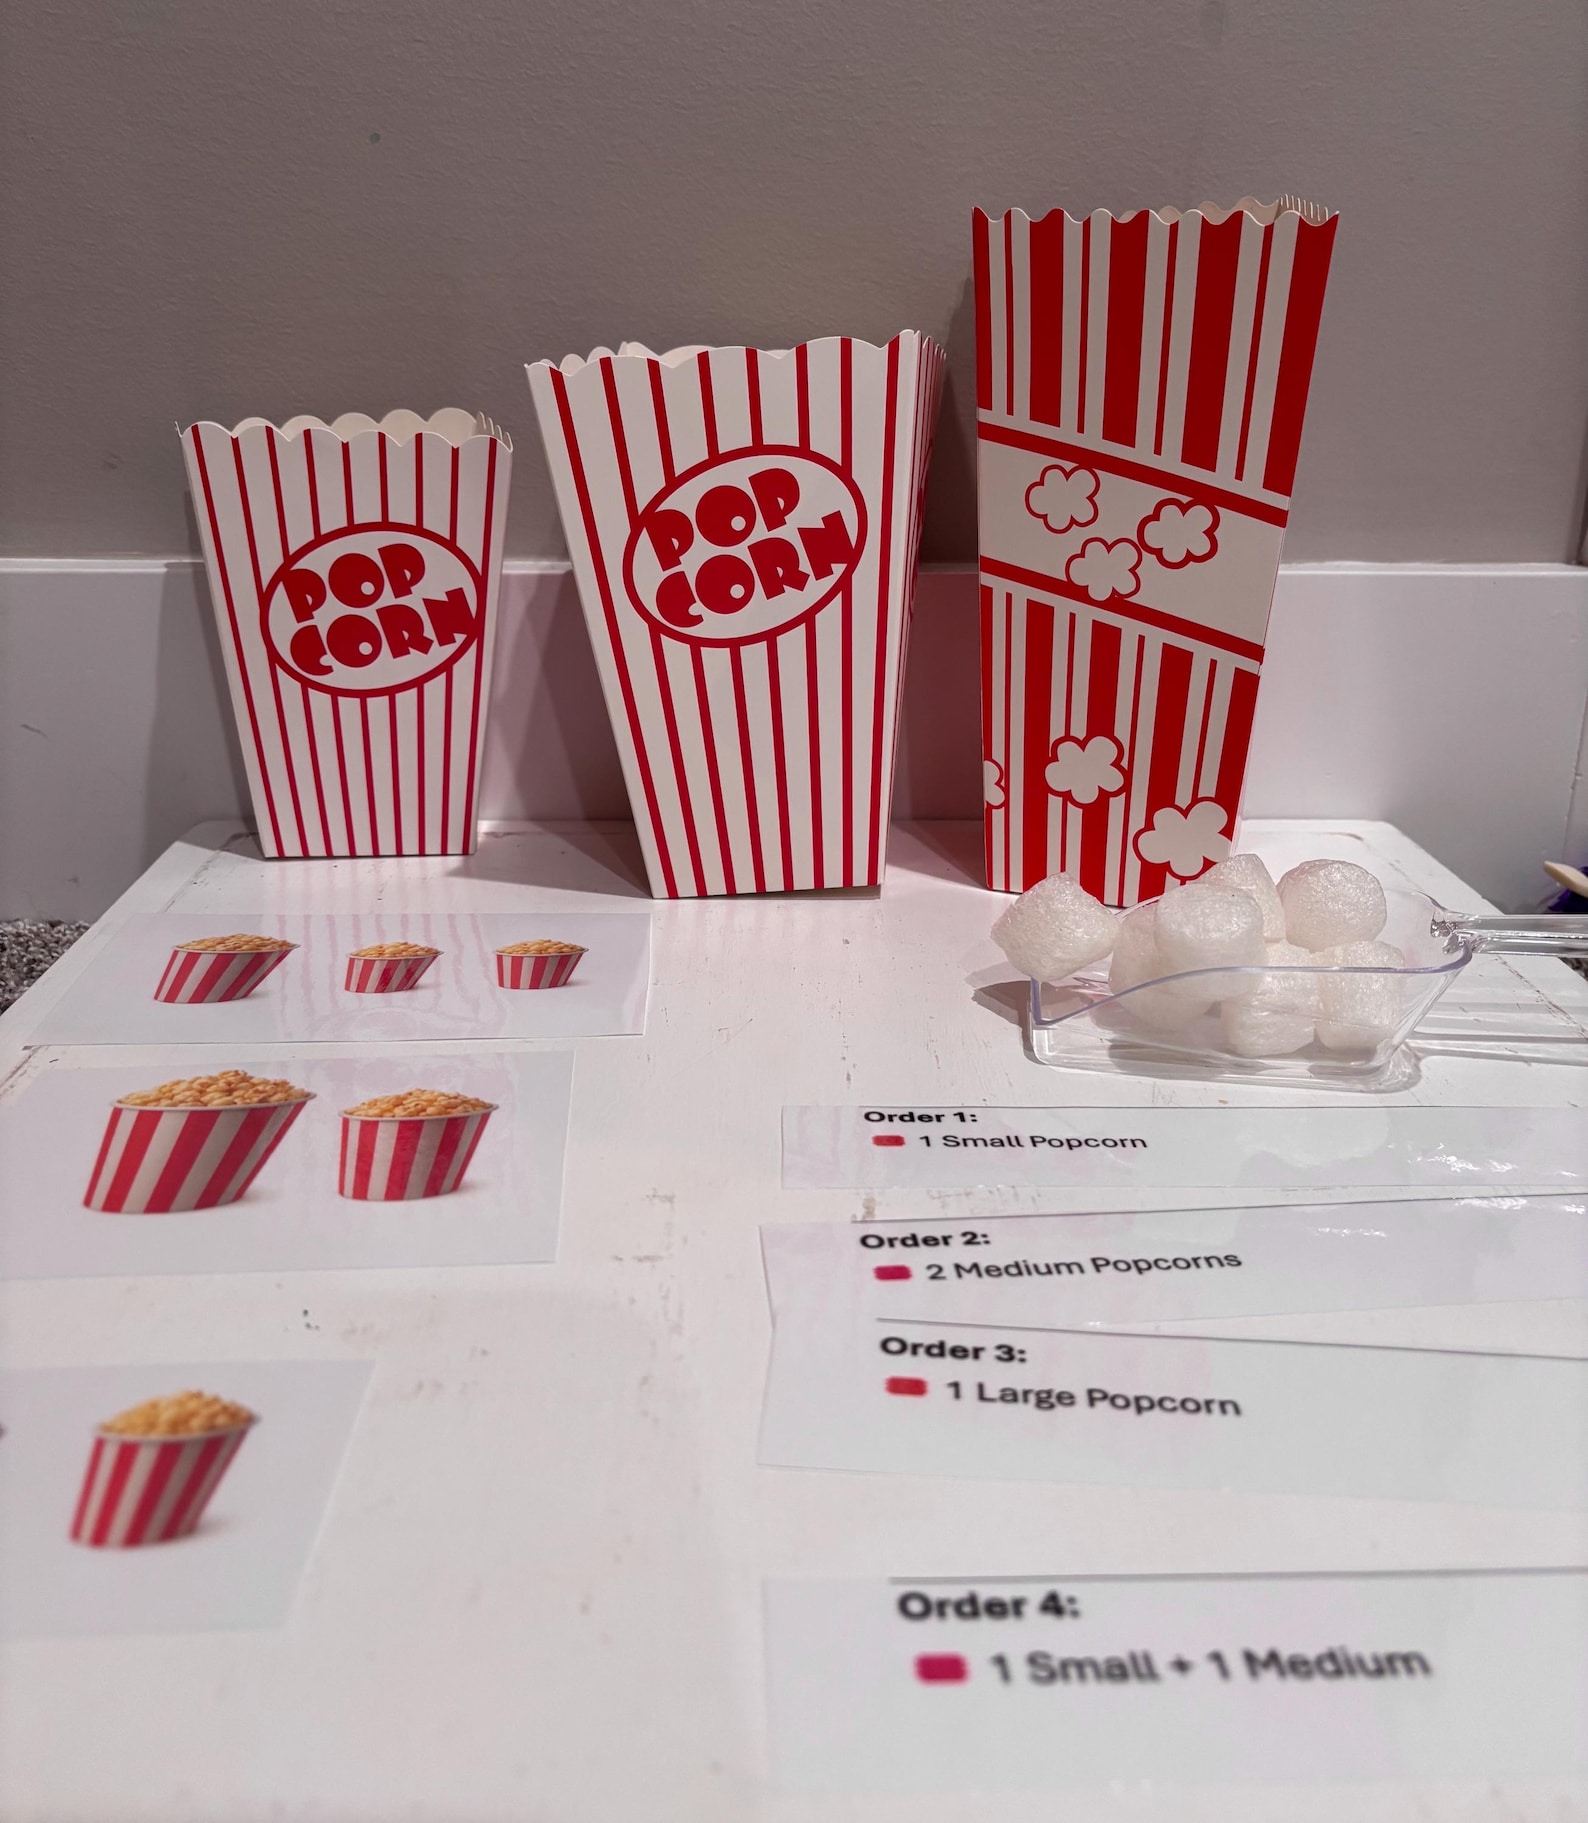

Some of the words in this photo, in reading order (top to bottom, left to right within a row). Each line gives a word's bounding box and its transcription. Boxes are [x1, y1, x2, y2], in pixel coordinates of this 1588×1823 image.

[644, 467, 801, 572] POP
[282, 543, 426, 624] POP
[655, 510, 856, 628] CORN
[290, 587, 476, 676] CORN
[863, 1110, 944, 1124] Order
[951, 1110, 979, 1124] 1:
[919, 1135, 932, 1148] 1
[941, 1134, 1025, 1149] Small
[1029, 1135, 1149, 1152] Popcorn
[859, 1232, 954, 1250] Order
[960, 1230, 991, 1247] 2:
[925, 1263, 947, 1281] 2
[953, 1259, 1086, 1280] Medium
[1090, 1251, 1243, 1276] Popcorns
[879, 1336, 987, 1361] Order
[993, 1343, 1028, 1364] 3:
[945, 1380, 963, 1401] 1
[975, 1380, 1077, 1412] Large
[1085, 1387, 1242, 1418] Popcorn
[896, 1591, 1028, 1622] Order
[1037, 1590, 1081, 1620] 4:
[990, 1653, 1013, 1685] 1
[1025, 1650, 1162, 1687] Small
[1169, 1655, 1194, 1677] +
[1206, 1650, 1231, 1681] 1
[1241, 1646, 1433, 1682] Medium
